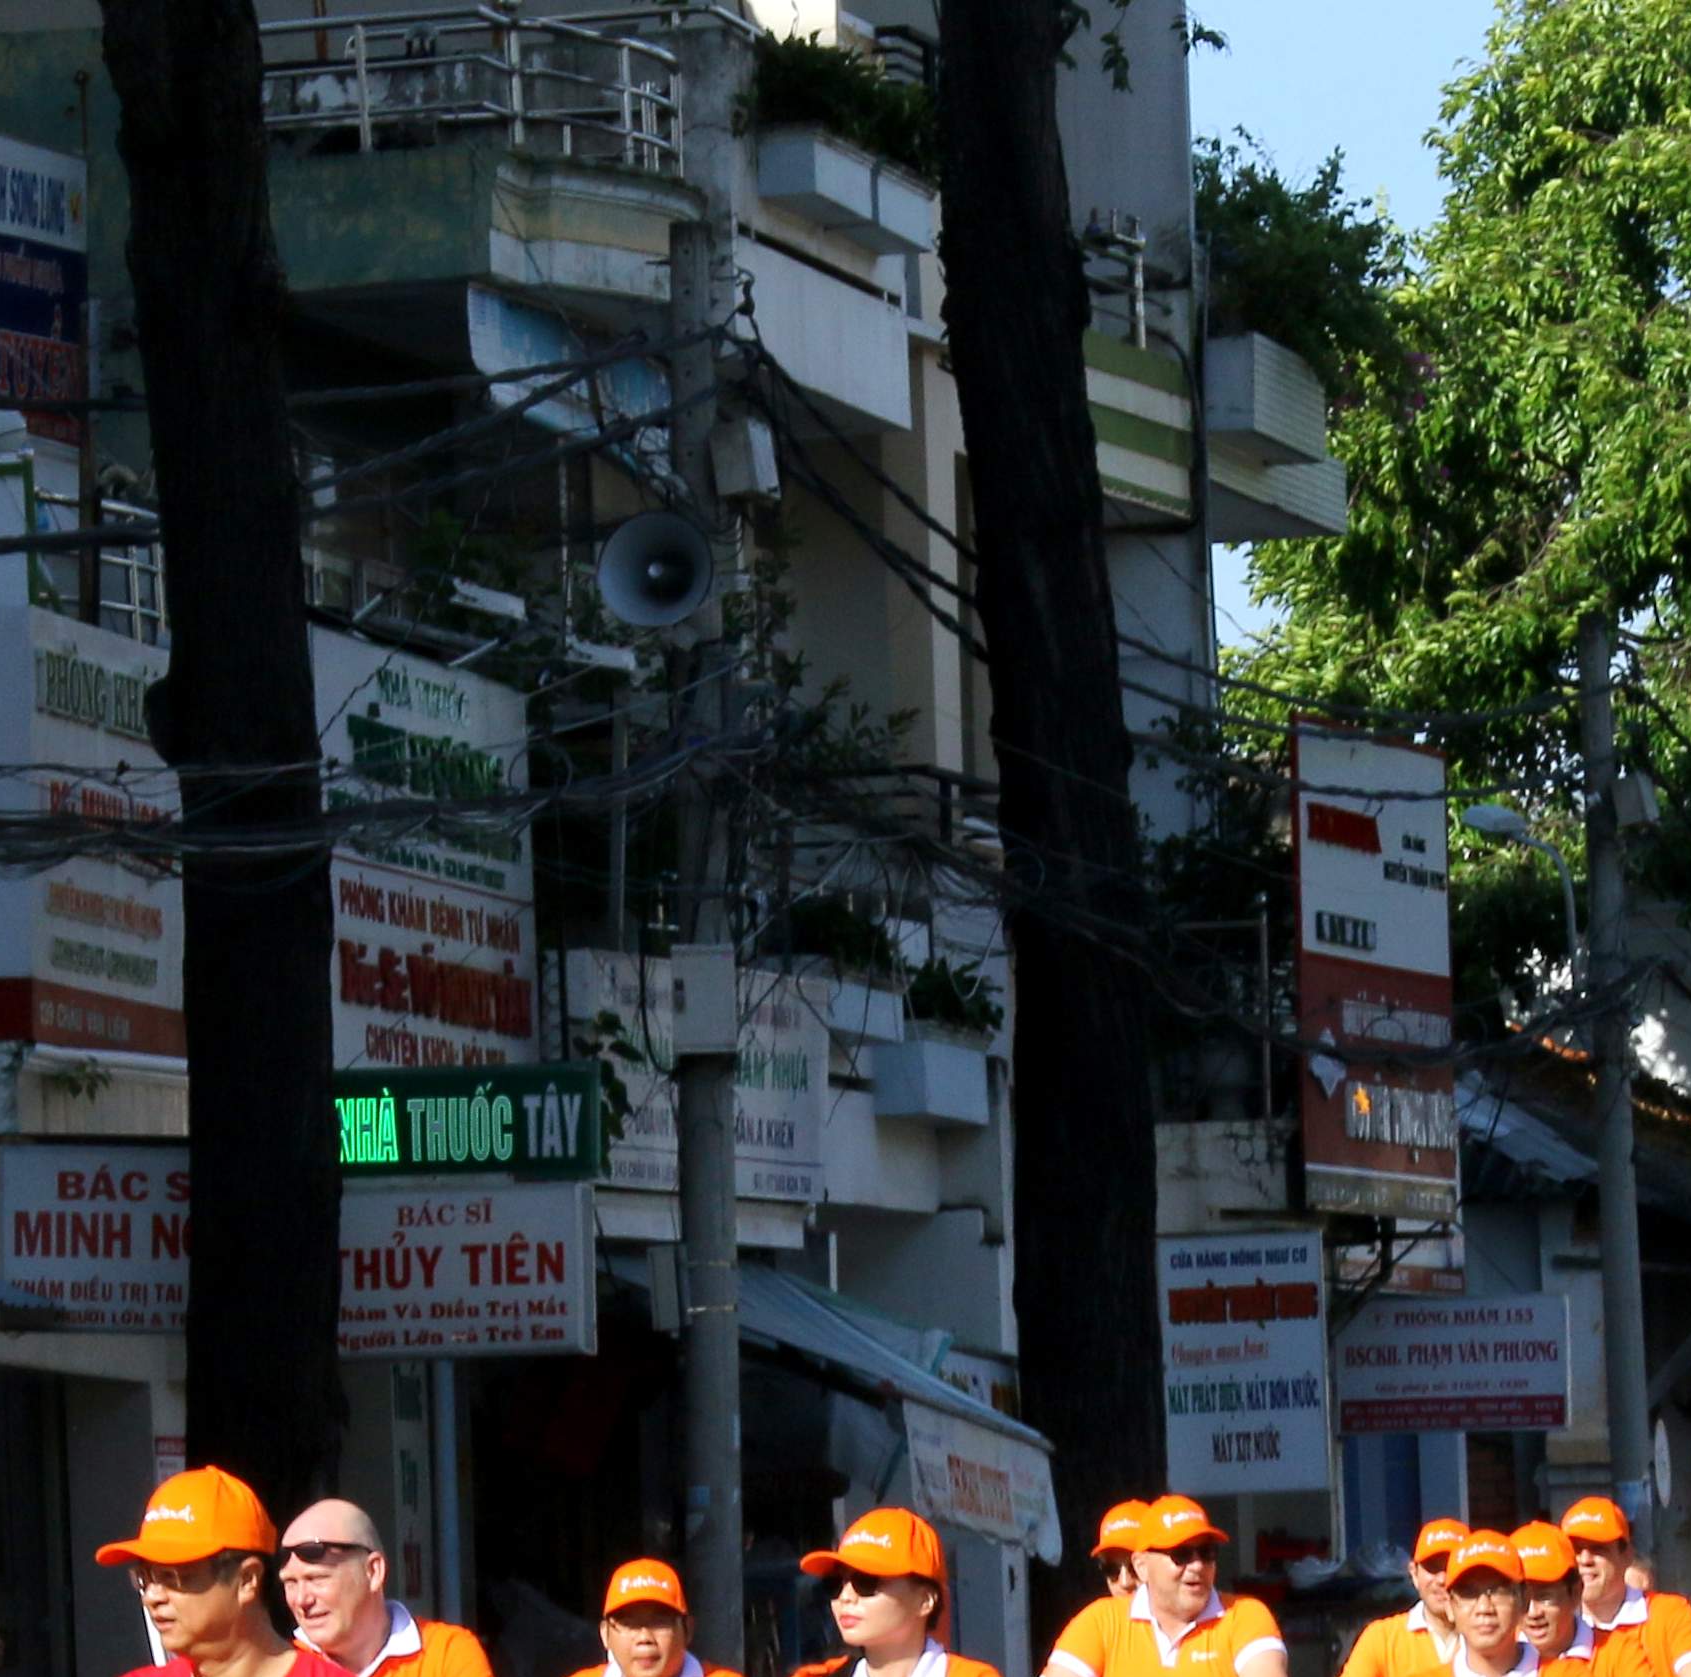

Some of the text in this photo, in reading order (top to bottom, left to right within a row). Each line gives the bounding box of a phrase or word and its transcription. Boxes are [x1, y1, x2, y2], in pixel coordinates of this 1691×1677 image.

[44, 642, 107, 727] PHÒNG
[339, 871, 385, 924] PHÒNG
[388, 884, 428, 932] KHÁM
[365, 1021, 419, 1067] CHUYÊN
[334, 1080, 583, 1164] NHÀ THUỐC TÂY
[57, 1163, 194, 1202] BÁC S
[396, 1197, 494, 1228] BÁC SĨ
[13, 1209, 132, 1259] MINH
[460, 1230, 566, 1288] TIÊN
[1169, 1247, 1193, 1270] CỬA
[1195, 1248, 1228, 1269] HÀNG
[341, 1301, 387, 1322] hám
[1394, 1307, 1449, 1328] PHÒNG
[1453, 1306, 1499, 1326] KHÁM
[530, 1323, 565, 1342] Em
[1406, 1342, 1453, 1369] PHẠM
[1457, 1339, 1488, 1364] VĂN
[1493, 1340, 1559, 1364] PHƯƠNG
[1167, 1375, 1190, 1415] MÁY
[1245, 1372, 1268, 1411] MÁY
[1211, 1422, 1233, 1463] MÁY
